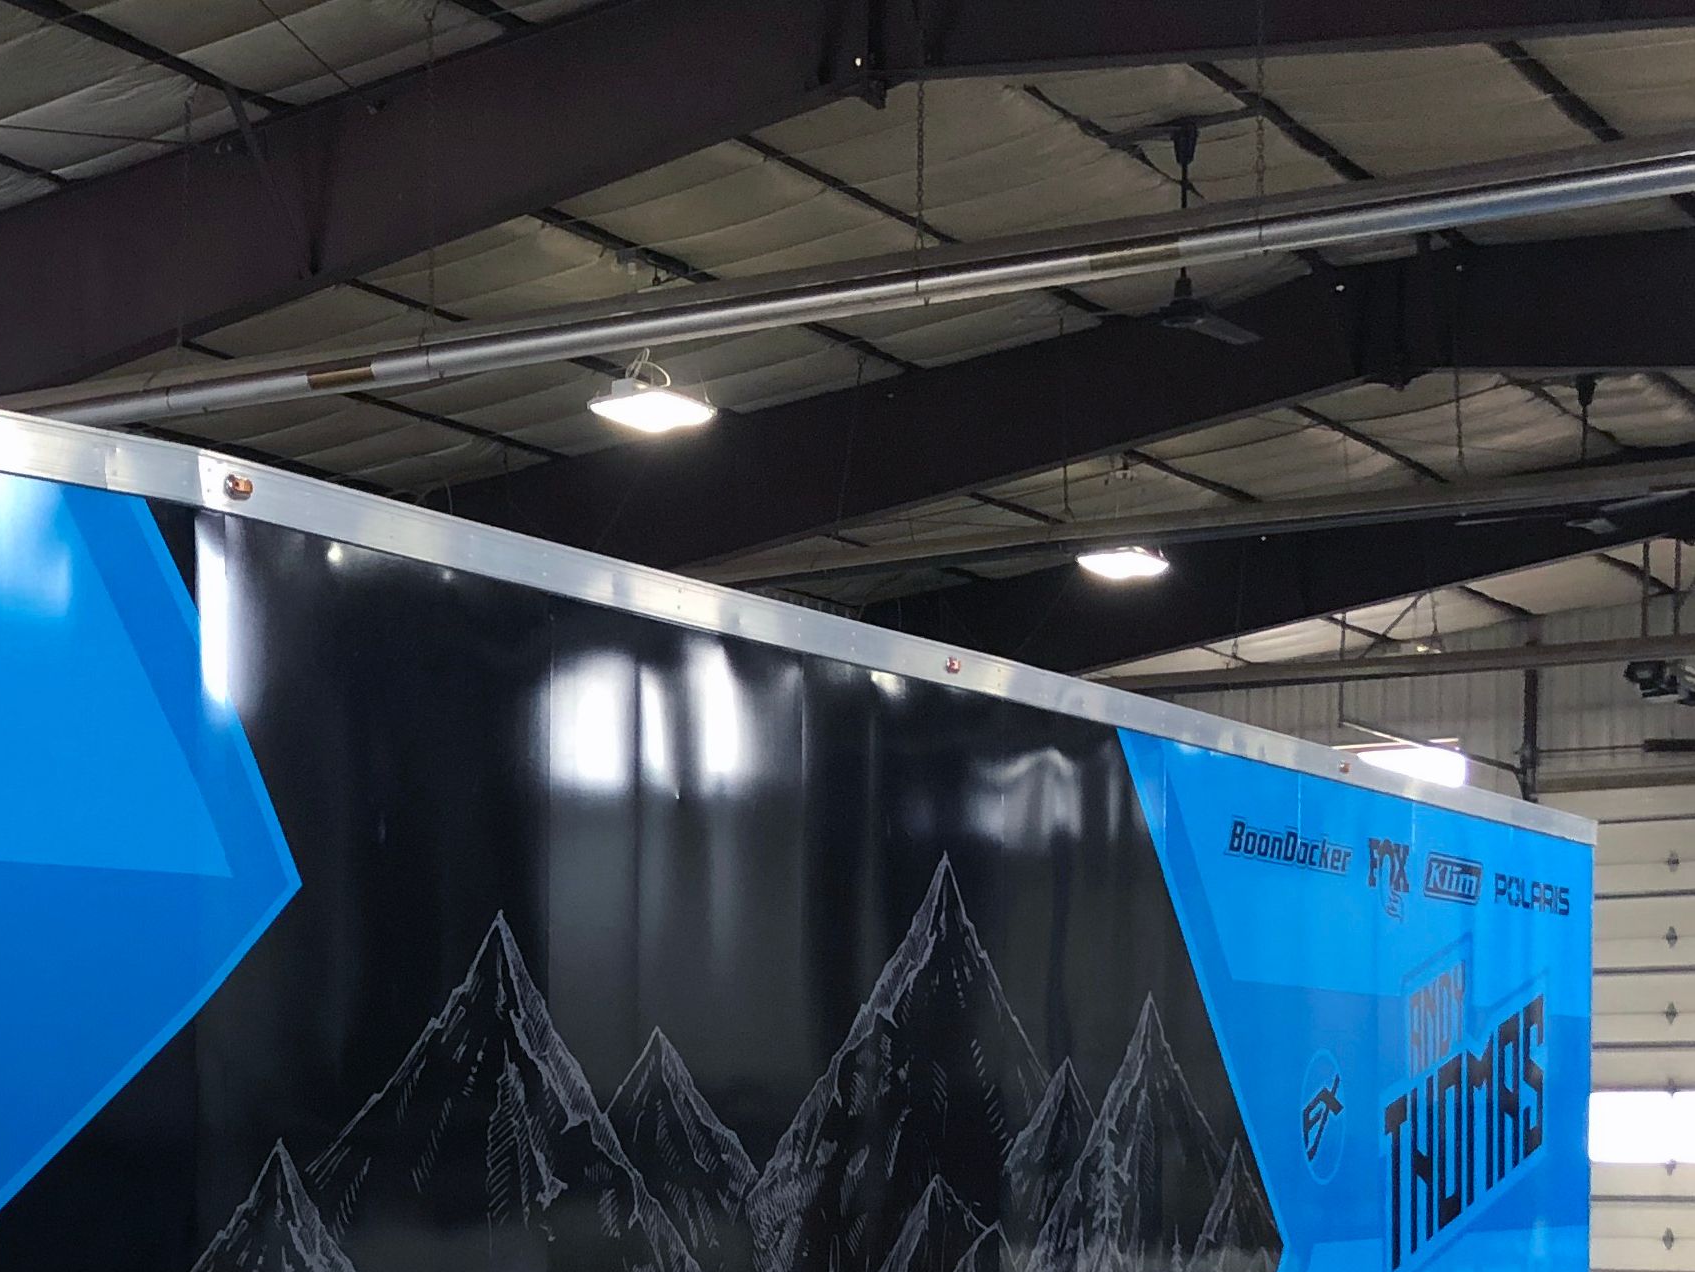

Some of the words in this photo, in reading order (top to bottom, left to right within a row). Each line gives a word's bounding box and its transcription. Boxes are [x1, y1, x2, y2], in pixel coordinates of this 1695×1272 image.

[1228, 819, 1353, 874] BoonDocker
[1368, 838, 1410, 902] FOX
[1494, 873, 1570, 916] POLARIS
[1409, 959, 1466, 1079] ANDY
[1384, 993, 1545, 1272] THOMAS
